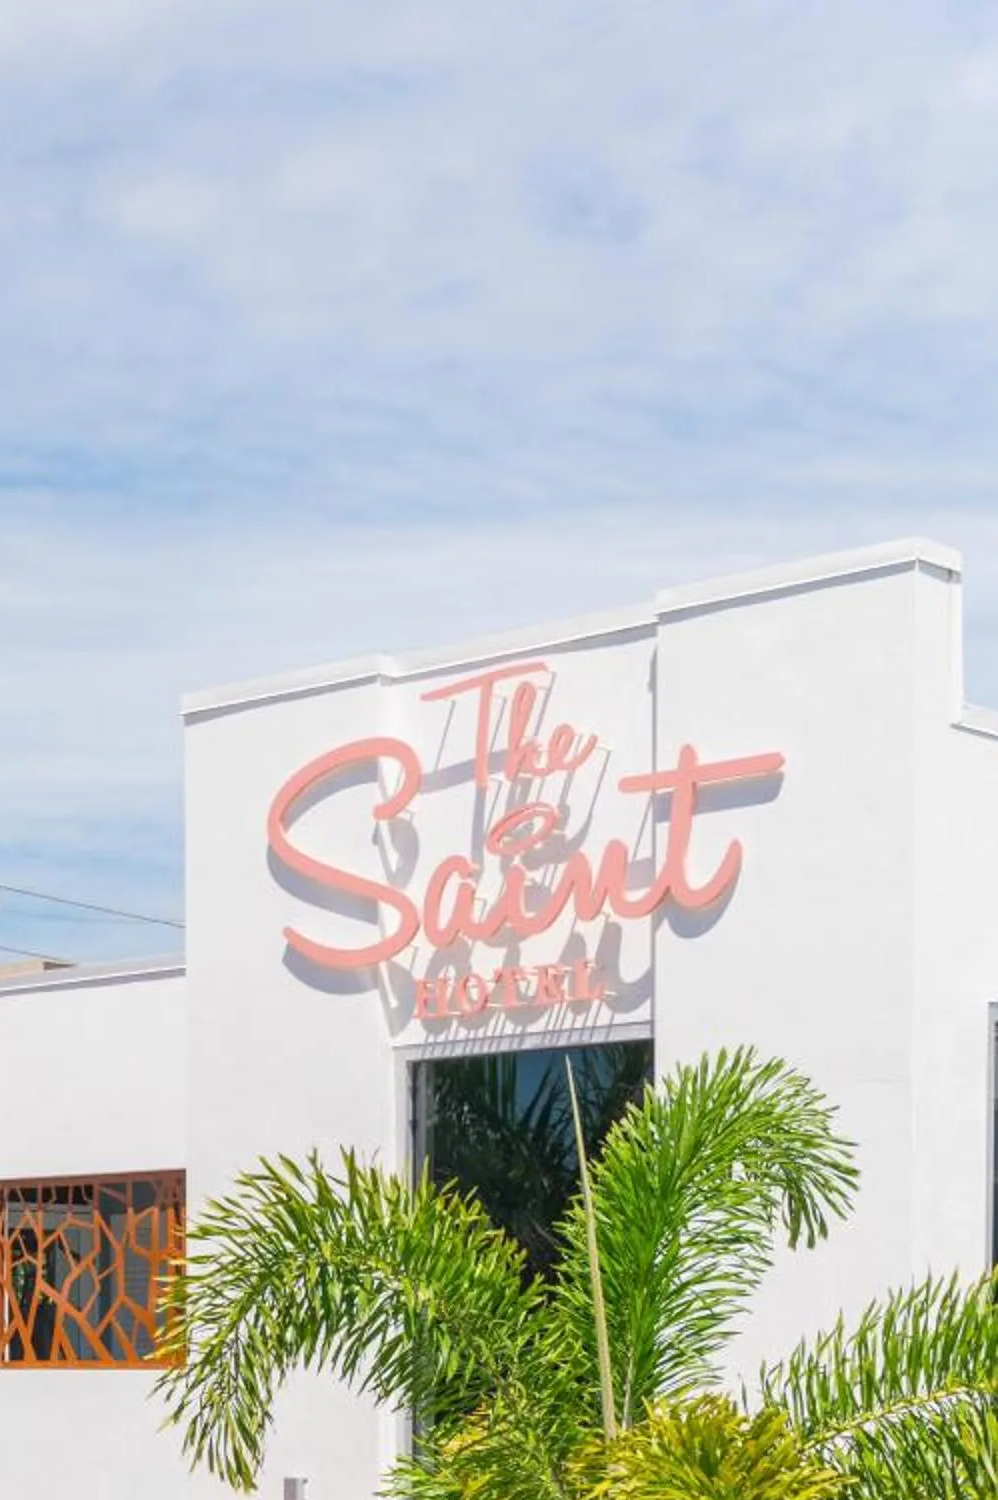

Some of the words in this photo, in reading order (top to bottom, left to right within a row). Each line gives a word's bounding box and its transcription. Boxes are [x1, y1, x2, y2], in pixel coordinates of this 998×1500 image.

[420, 661, 598, 788] The
[267, 736, 785, 969] Saint
[413, 957, 608, 1020] HOTEL
